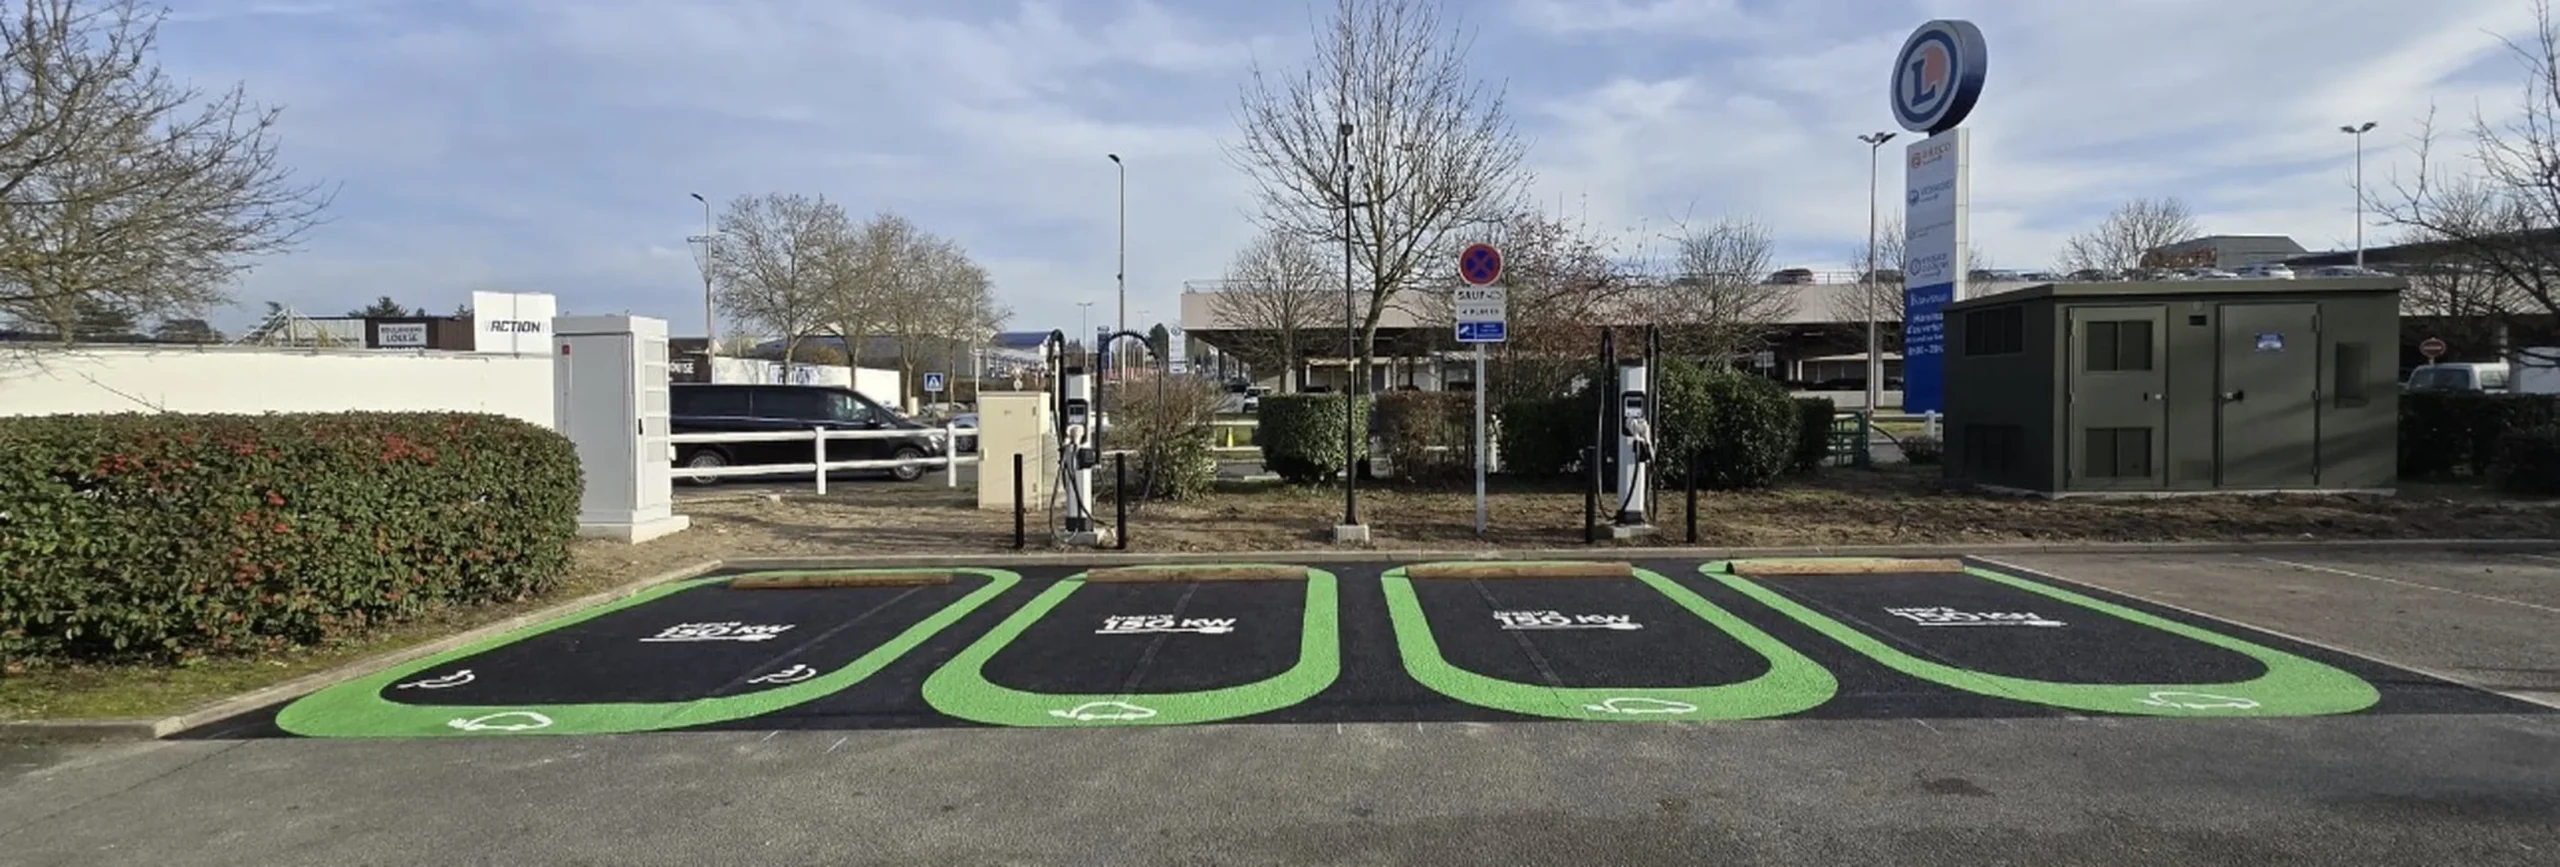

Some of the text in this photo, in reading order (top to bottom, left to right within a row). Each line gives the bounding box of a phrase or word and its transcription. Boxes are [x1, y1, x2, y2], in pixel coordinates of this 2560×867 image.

[1911, 59, 1936, 107] L
[1458, 290, 1484, 300] SAUF
[491, 320, 540, 333] ACTION
[1104, 618, 1237, 630] 150 KW
[1494, 615, 1572, 627] 150
